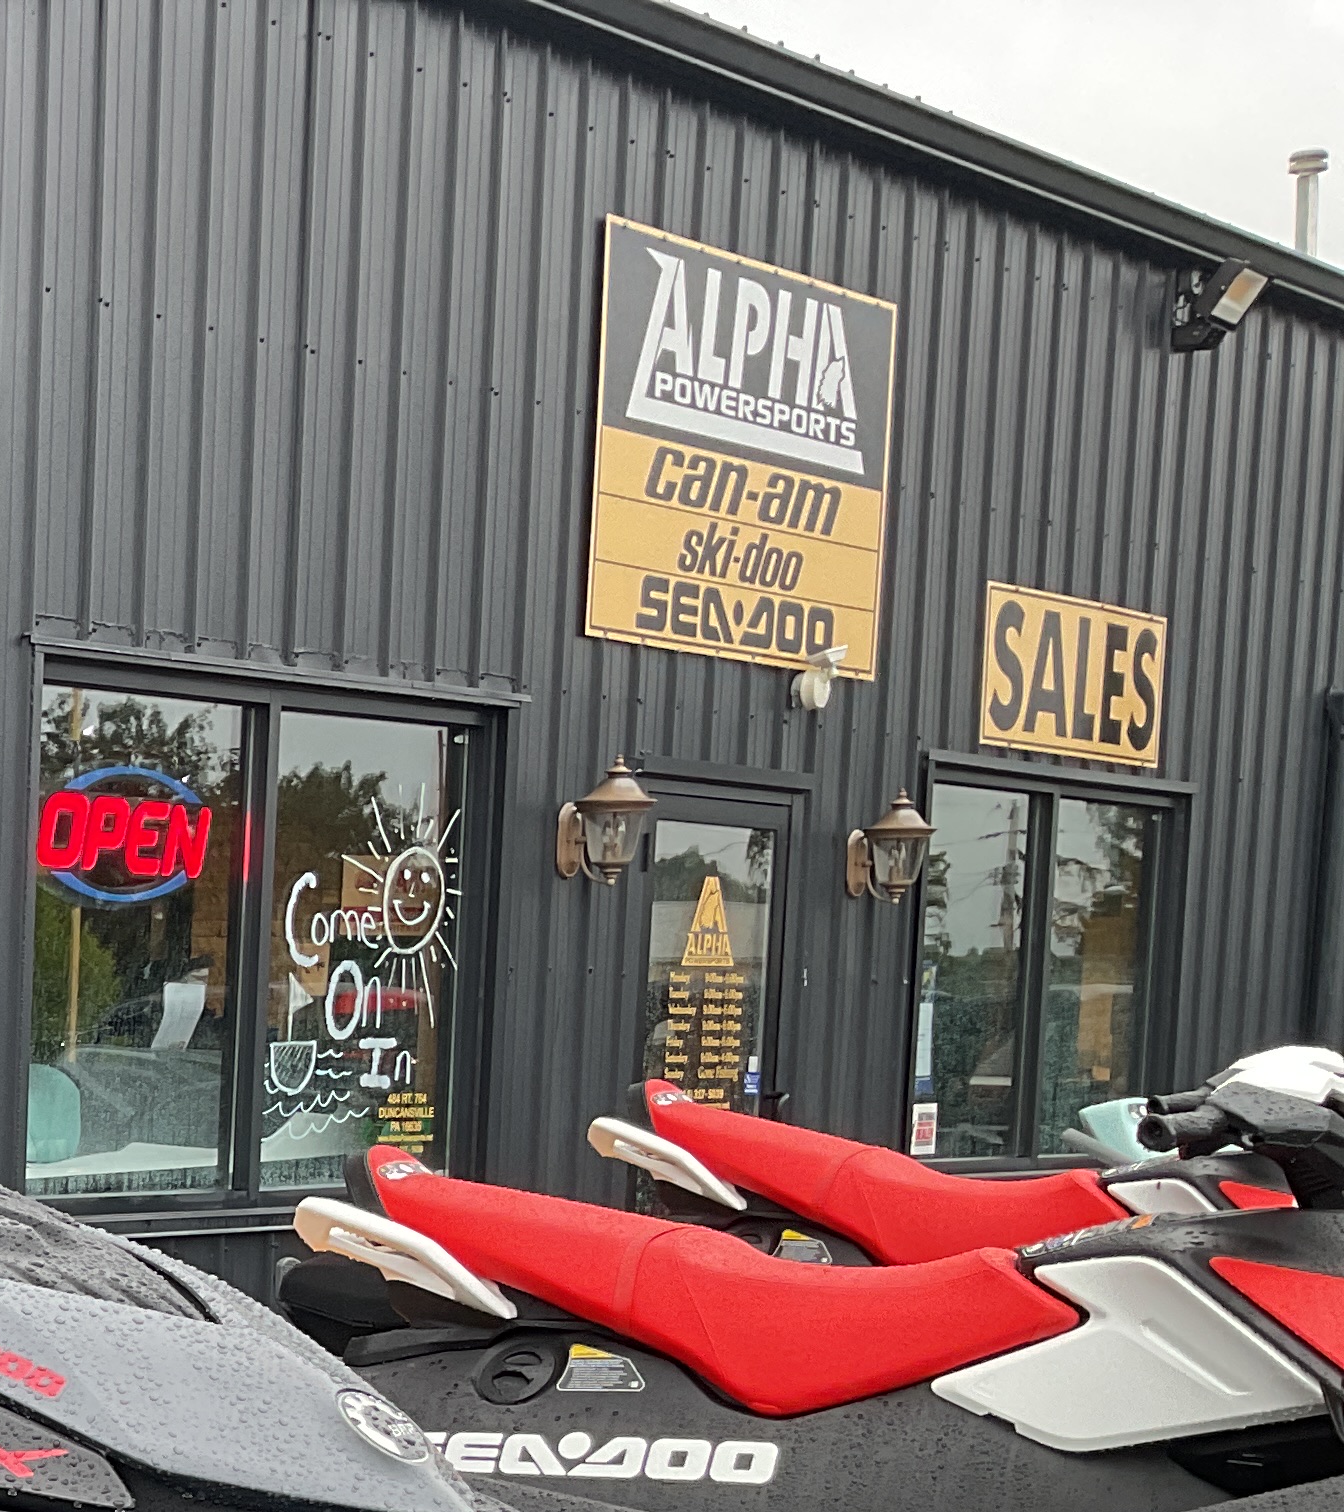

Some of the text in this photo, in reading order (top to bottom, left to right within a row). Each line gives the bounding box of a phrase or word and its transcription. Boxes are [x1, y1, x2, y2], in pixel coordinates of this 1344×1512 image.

[626, 247, 858, 420] ALPHA
[654, 371, 857, 447] POWERSPORTS
[644, 446, 842, 537] can-am
[677, 521, 804, 592] ski-doo
[989, 600, 1158, 751] SALES
[37, 791, 212, 879] OPEN
[285, 871, 378, 967] Come
[686, 932, 732, 956] ALPHA
[325, 960, 381, 1041] On
[359, 1037, 411, 1090] In
[378, 1107, 435, 1118] DUNCANSVILLE
[390, 1121, 400, 1132] PA
